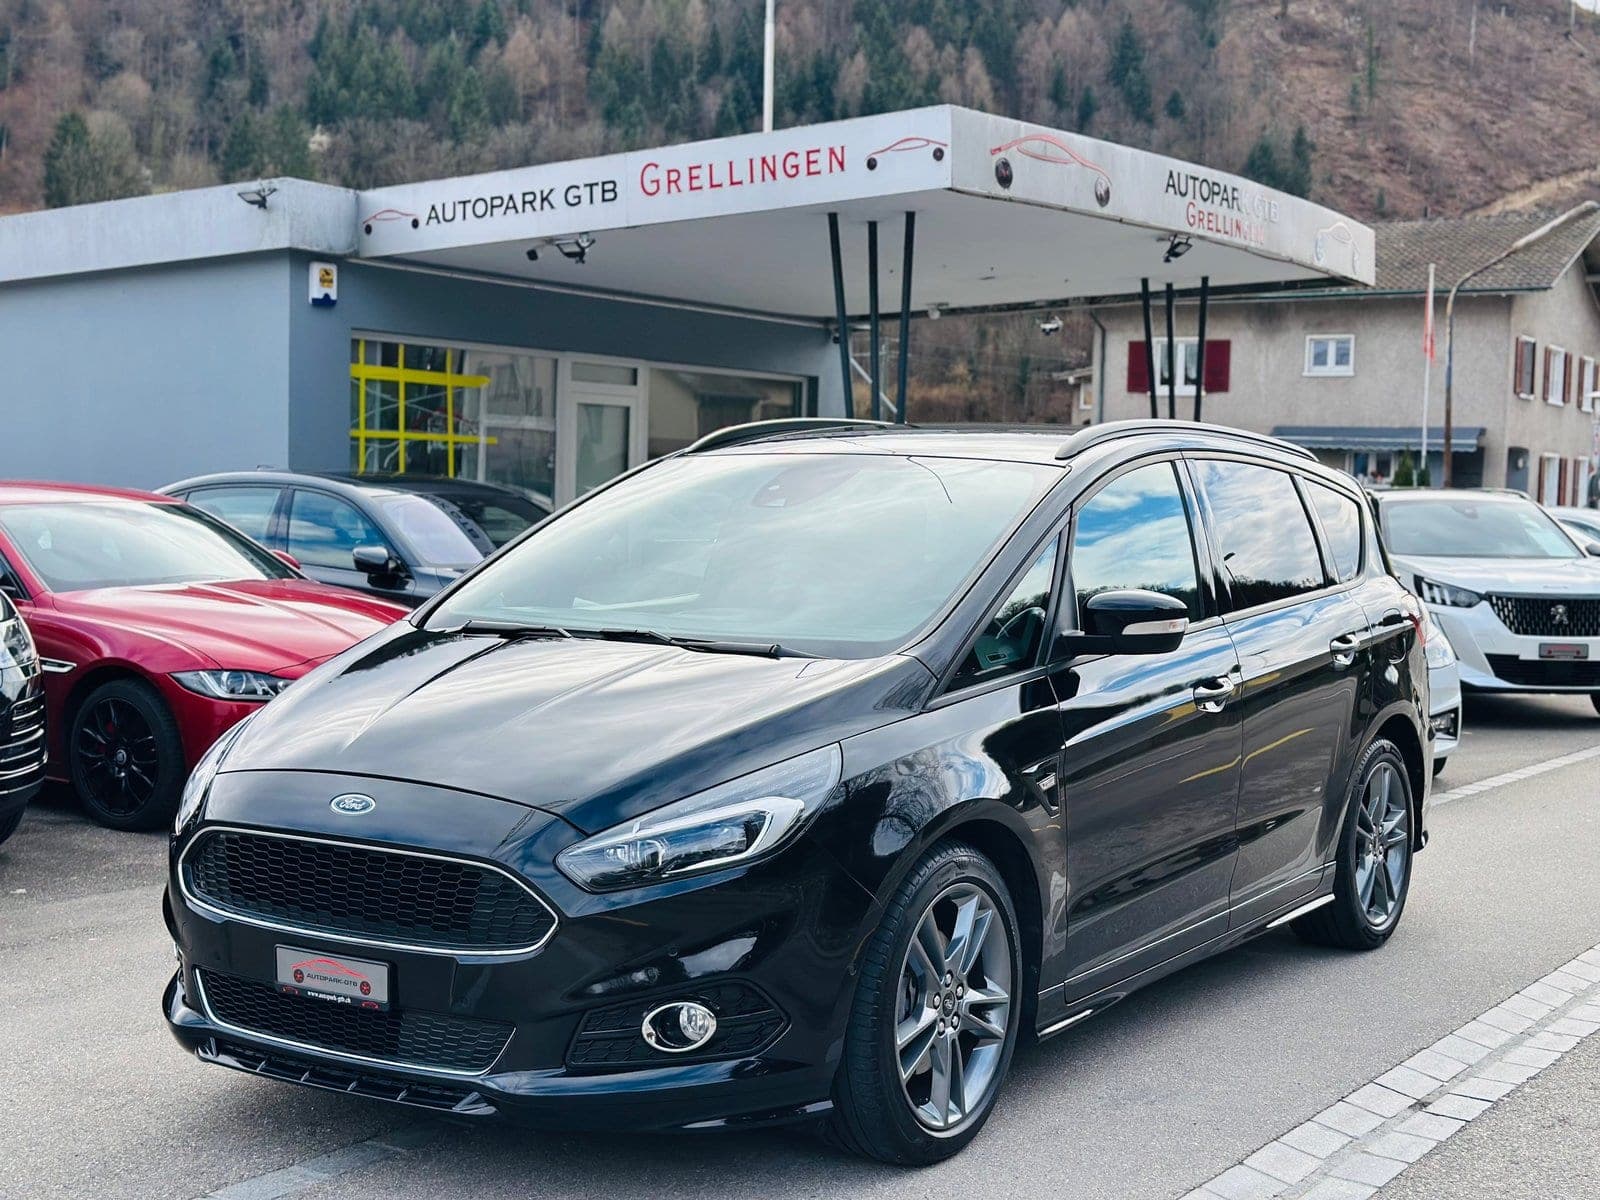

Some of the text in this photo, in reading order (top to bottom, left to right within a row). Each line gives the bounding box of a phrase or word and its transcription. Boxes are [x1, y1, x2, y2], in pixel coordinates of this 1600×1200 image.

[425, 145, 846, 226] AUTOPARK GTB GRELLINGEN
[1186, 201, 1264, 245] GRELLIN
